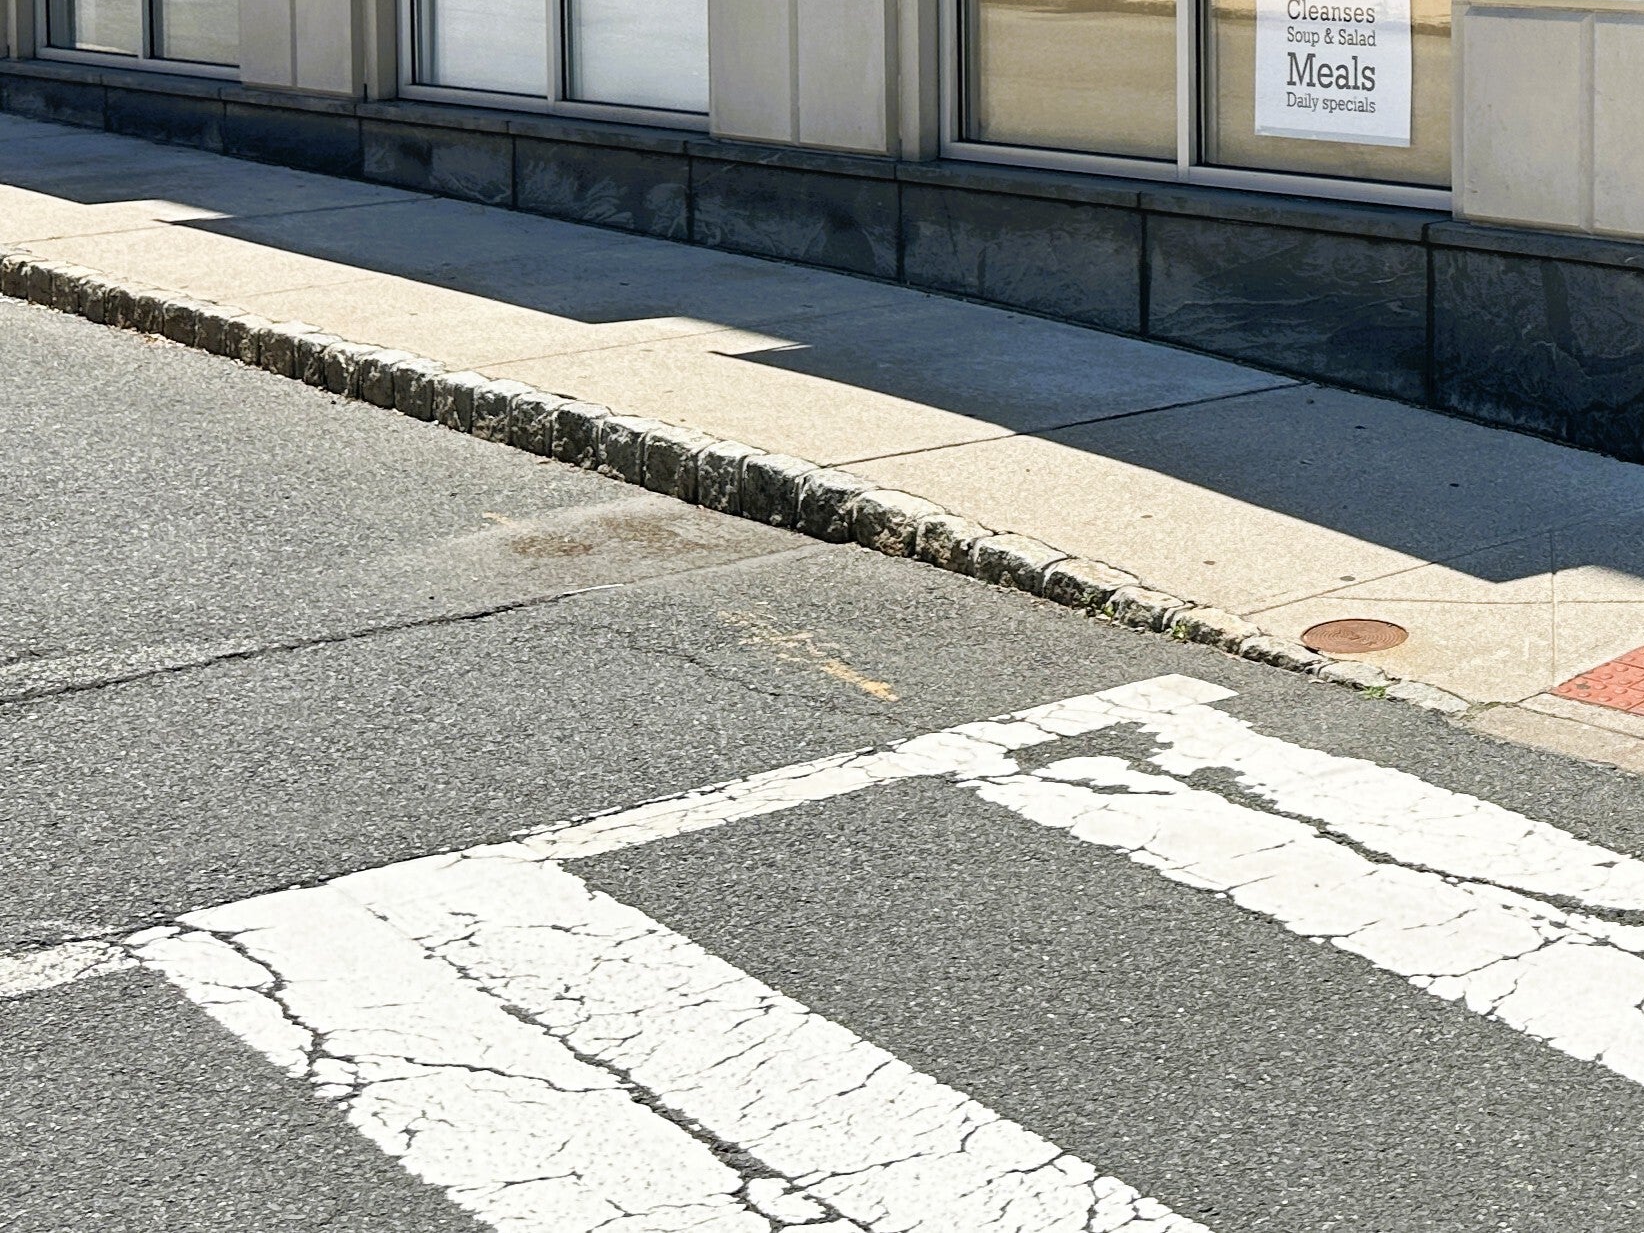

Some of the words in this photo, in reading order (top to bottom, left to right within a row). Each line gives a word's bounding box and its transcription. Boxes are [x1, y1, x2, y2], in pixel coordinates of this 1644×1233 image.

[1287, 26, 1321, 47] Soup
[1323, 28, 1335, 45] &
[1337, 28, 1377, 47] Salad
[1286, 51, 1376, 92] Meals
[1286, 91, 1320, 111] Daily
[1321, 94, 1376, 114] specials
